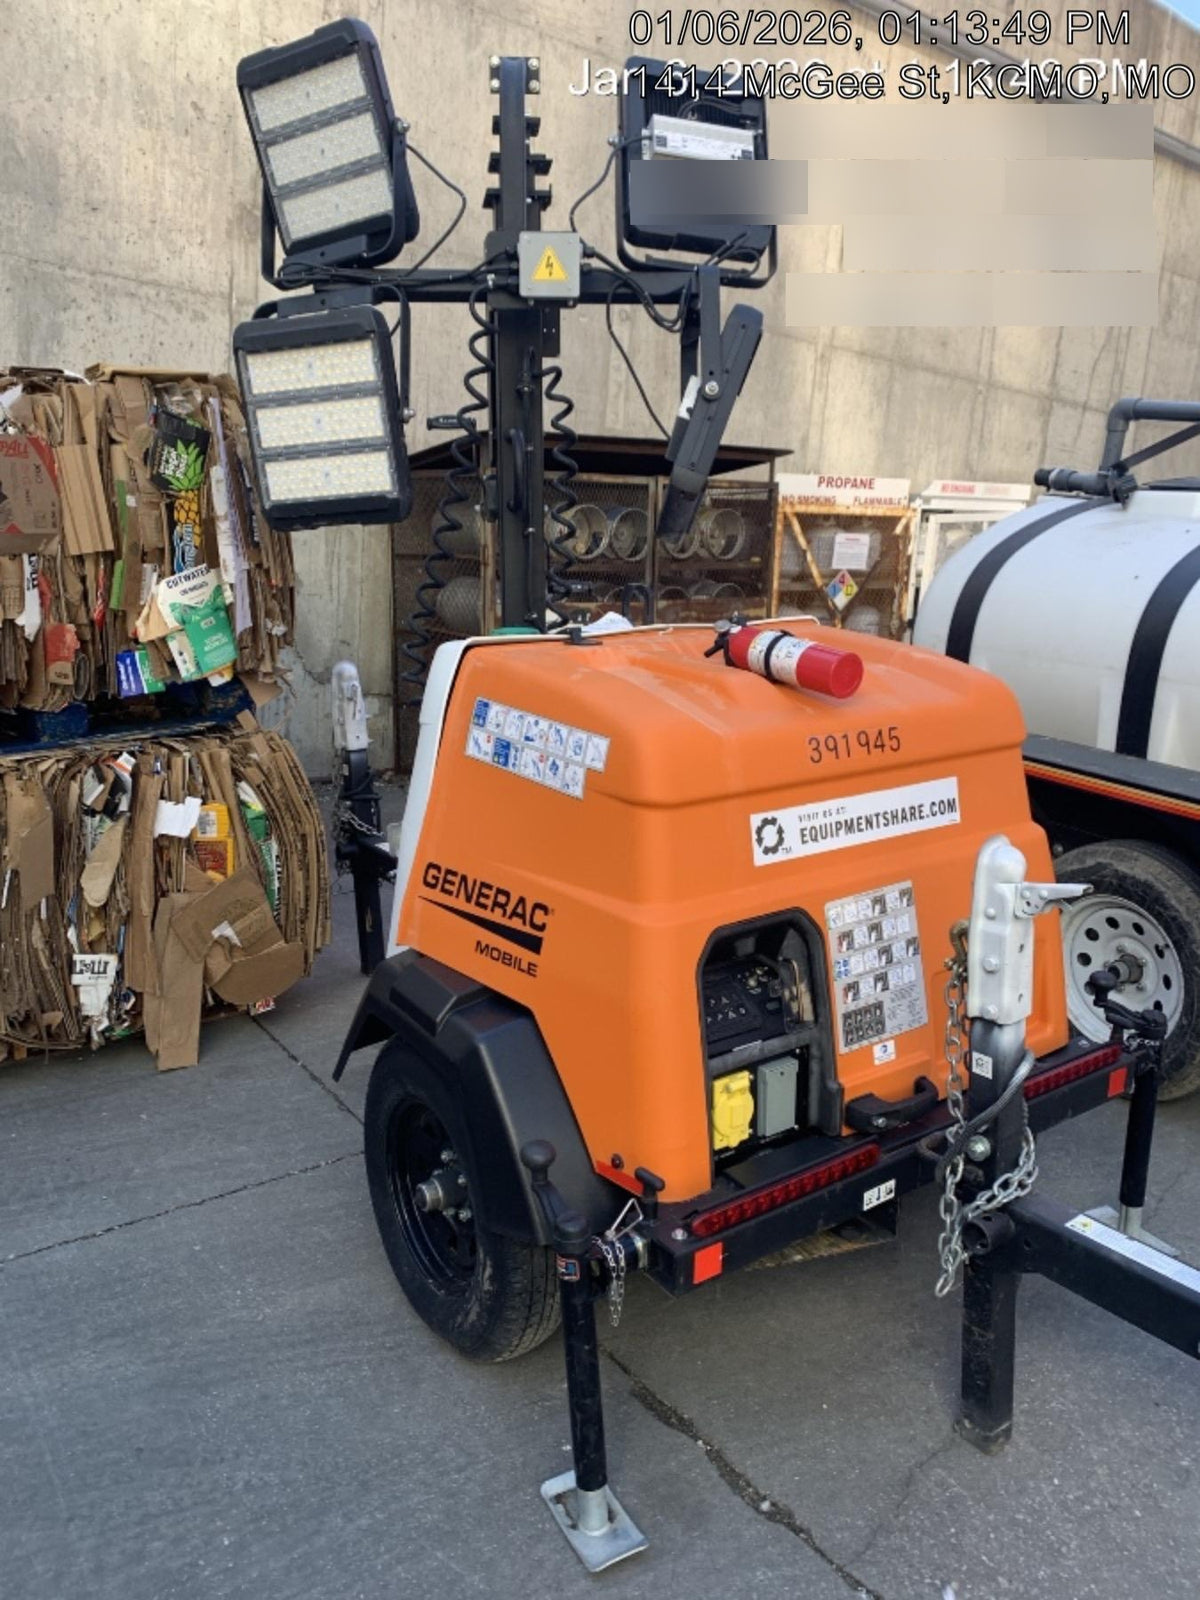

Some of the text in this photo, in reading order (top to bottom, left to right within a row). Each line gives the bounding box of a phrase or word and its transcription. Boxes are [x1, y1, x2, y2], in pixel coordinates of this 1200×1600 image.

[797, 495, 836, 506] SMOKING
[852, 496, 902, 507] FLAMMABLE
[818, 475, 876, 491] PROPANE
[807, 726, 901, 764] 391945
[800, 797, 957, 846] EQUIPMENTSHARE.COM
[422, 862, 549, 932] GENERAC
[475, 940, 538, 977] MOBILE
